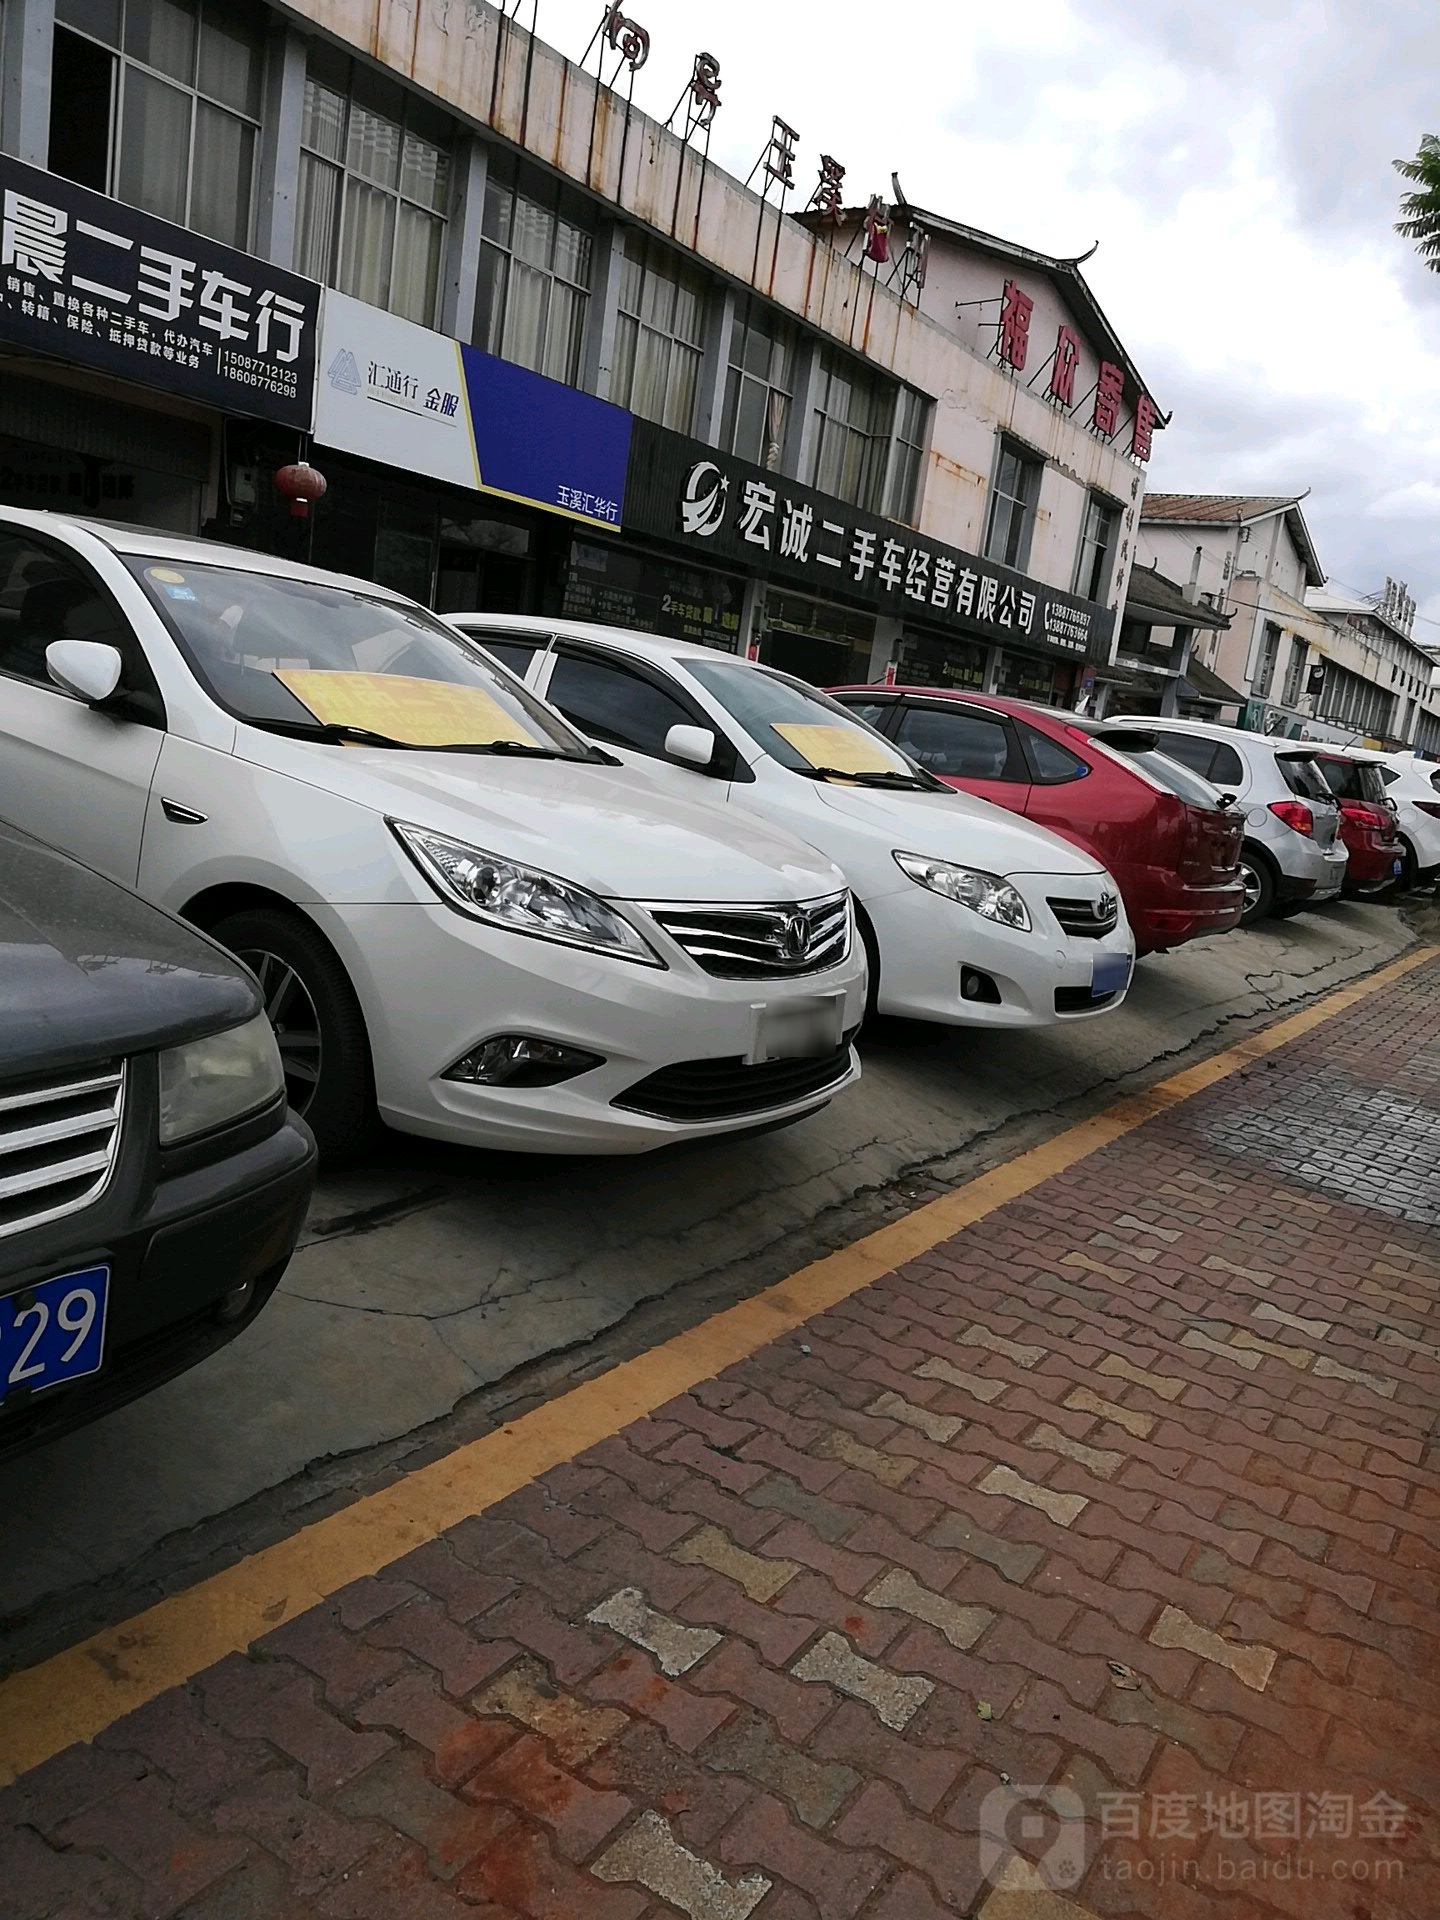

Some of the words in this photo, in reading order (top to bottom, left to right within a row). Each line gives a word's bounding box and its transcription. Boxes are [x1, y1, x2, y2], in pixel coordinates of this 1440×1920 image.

[2, 189, 305, 363] 晨二手车行
[0, 293, 200, 369] 、转籍、保险、抵押贷款等业务
[222, 366, 297, 399] 18608776298
[224, 350, 298, 384] 15087712123
[367, 361, 419, 400] 汇通行
[423, 388, 460, 418] 金服
[557, 484, 618, 523] 玉溪汇华行
[738, 480, 1035, 635] 宏诚二手车经营有限公司
[0, 1288, 97, 1384] 29
